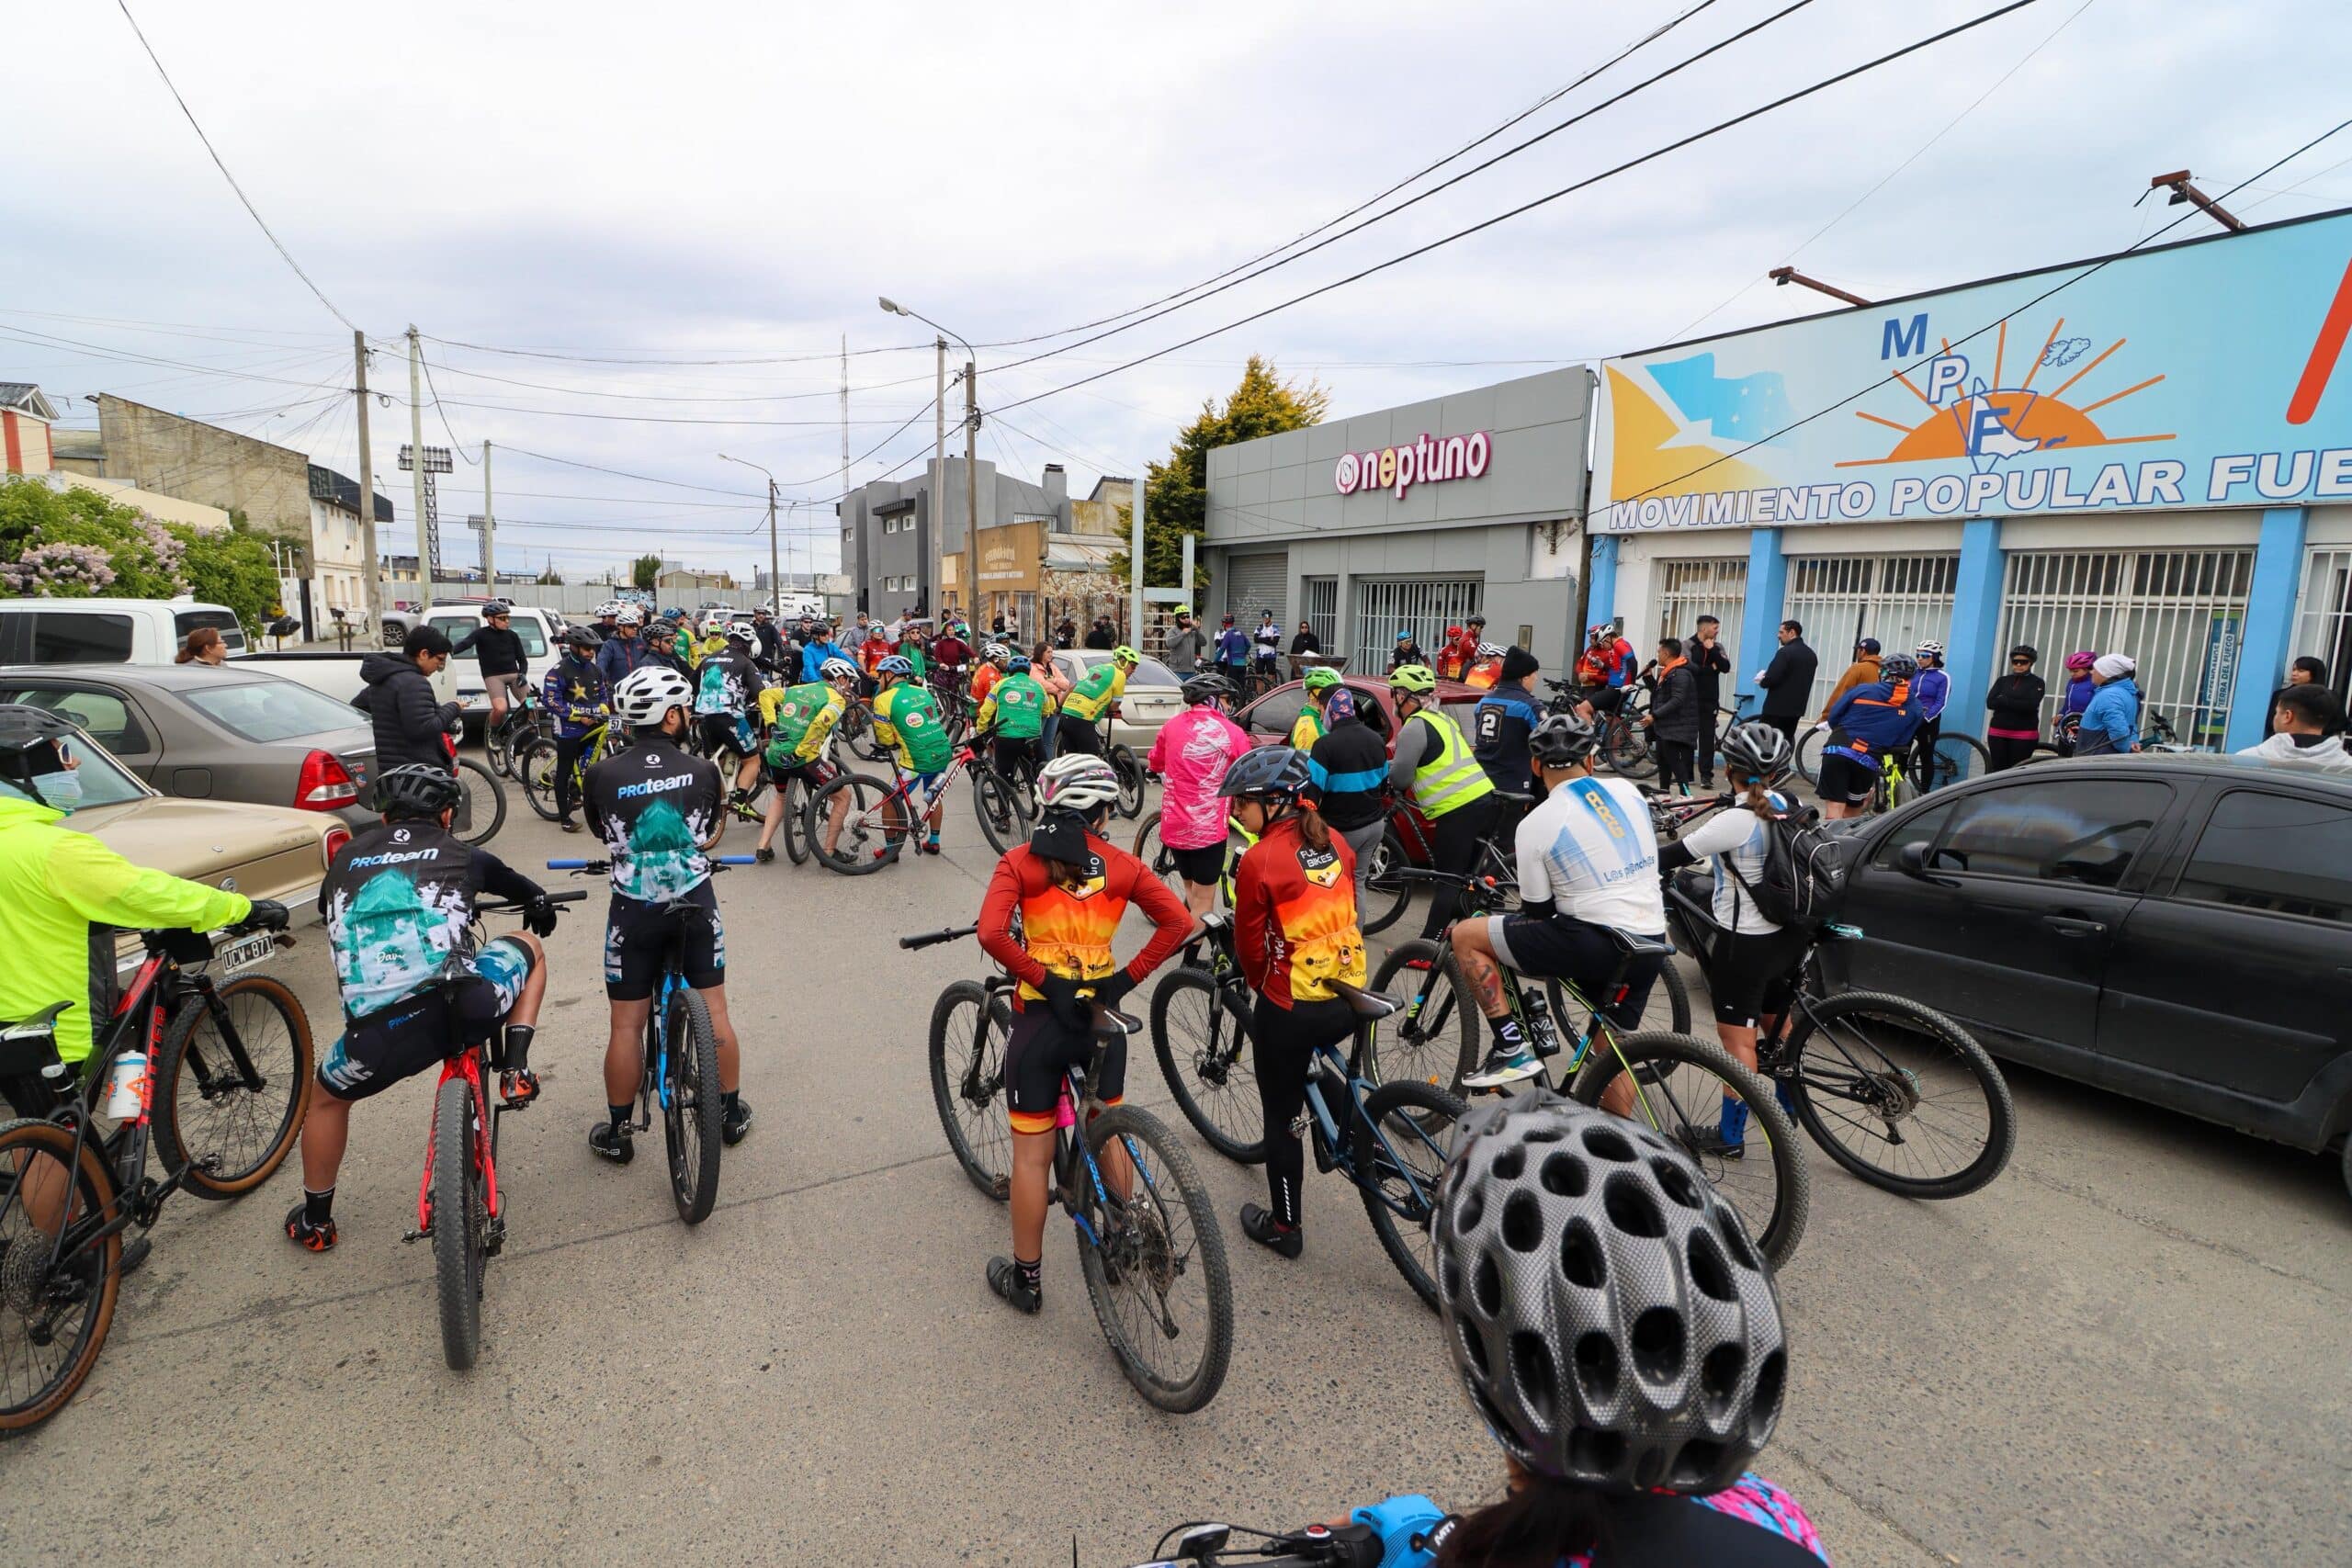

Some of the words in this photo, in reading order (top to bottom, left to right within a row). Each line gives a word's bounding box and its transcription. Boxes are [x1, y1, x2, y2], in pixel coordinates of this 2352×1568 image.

[1881, 312, 1928, 360] M
[1928, 355, 1970, 405] P
[1970, 407, 2010, 457] F
[1361, 432, 1491, 500] neptuno
[1610, 480, 1875, 529] MOVIMIENTO
[1890, 459, 2186, 516] POPULAR
[610, 719, 620, 729] 57
[1481, 713, 1497, 737] 2
[1306, 852, 1333, 868] BIKES
[251, 937, 273, 958] 871
